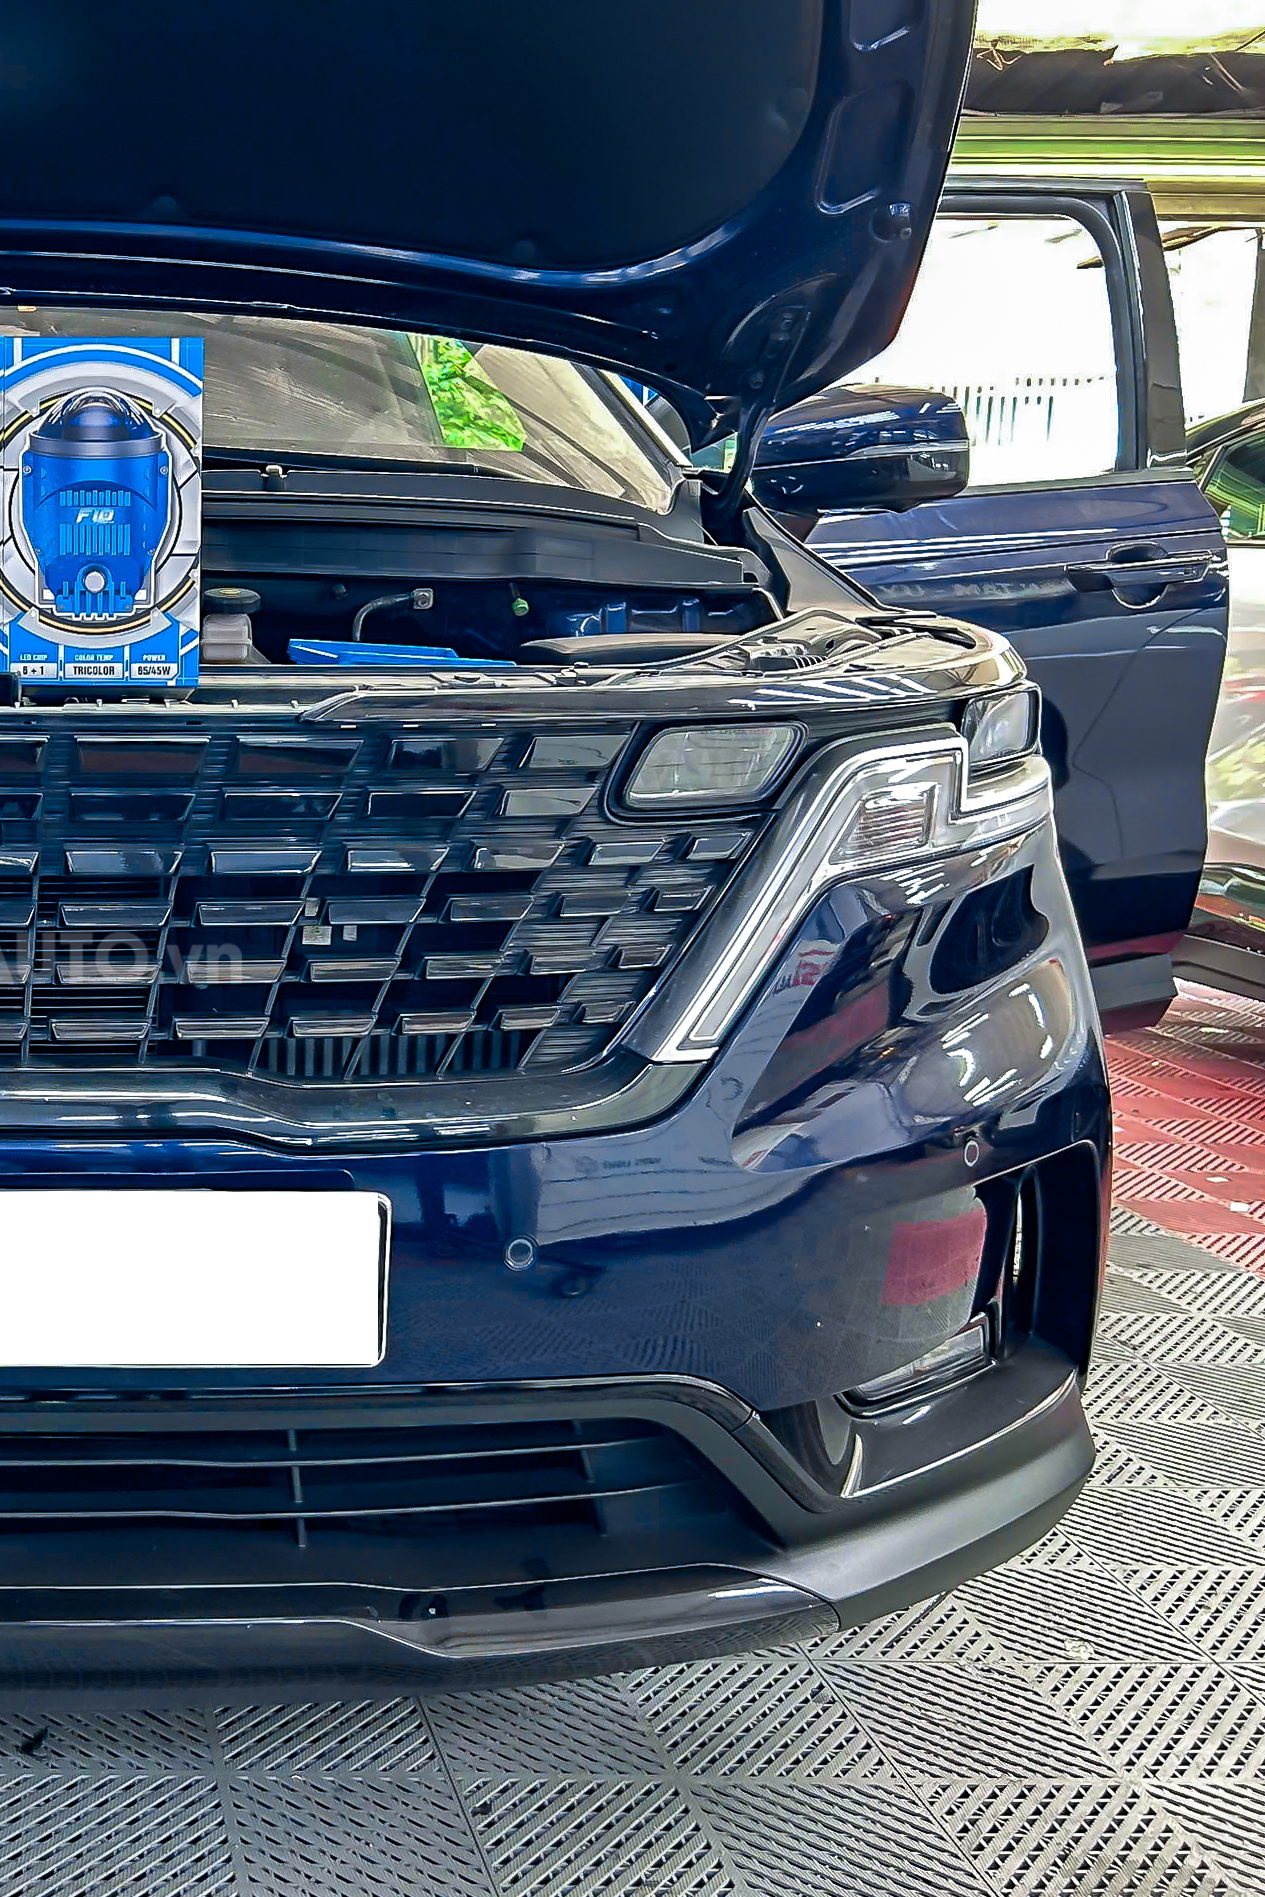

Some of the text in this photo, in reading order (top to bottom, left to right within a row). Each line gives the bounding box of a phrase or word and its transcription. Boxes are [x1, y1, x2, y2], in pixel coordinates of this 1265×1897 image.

[76, 508, 115, 523] F10
[142, 654, 166, 662] POWER
[72, 665, 115, 676] TRICOLOR
